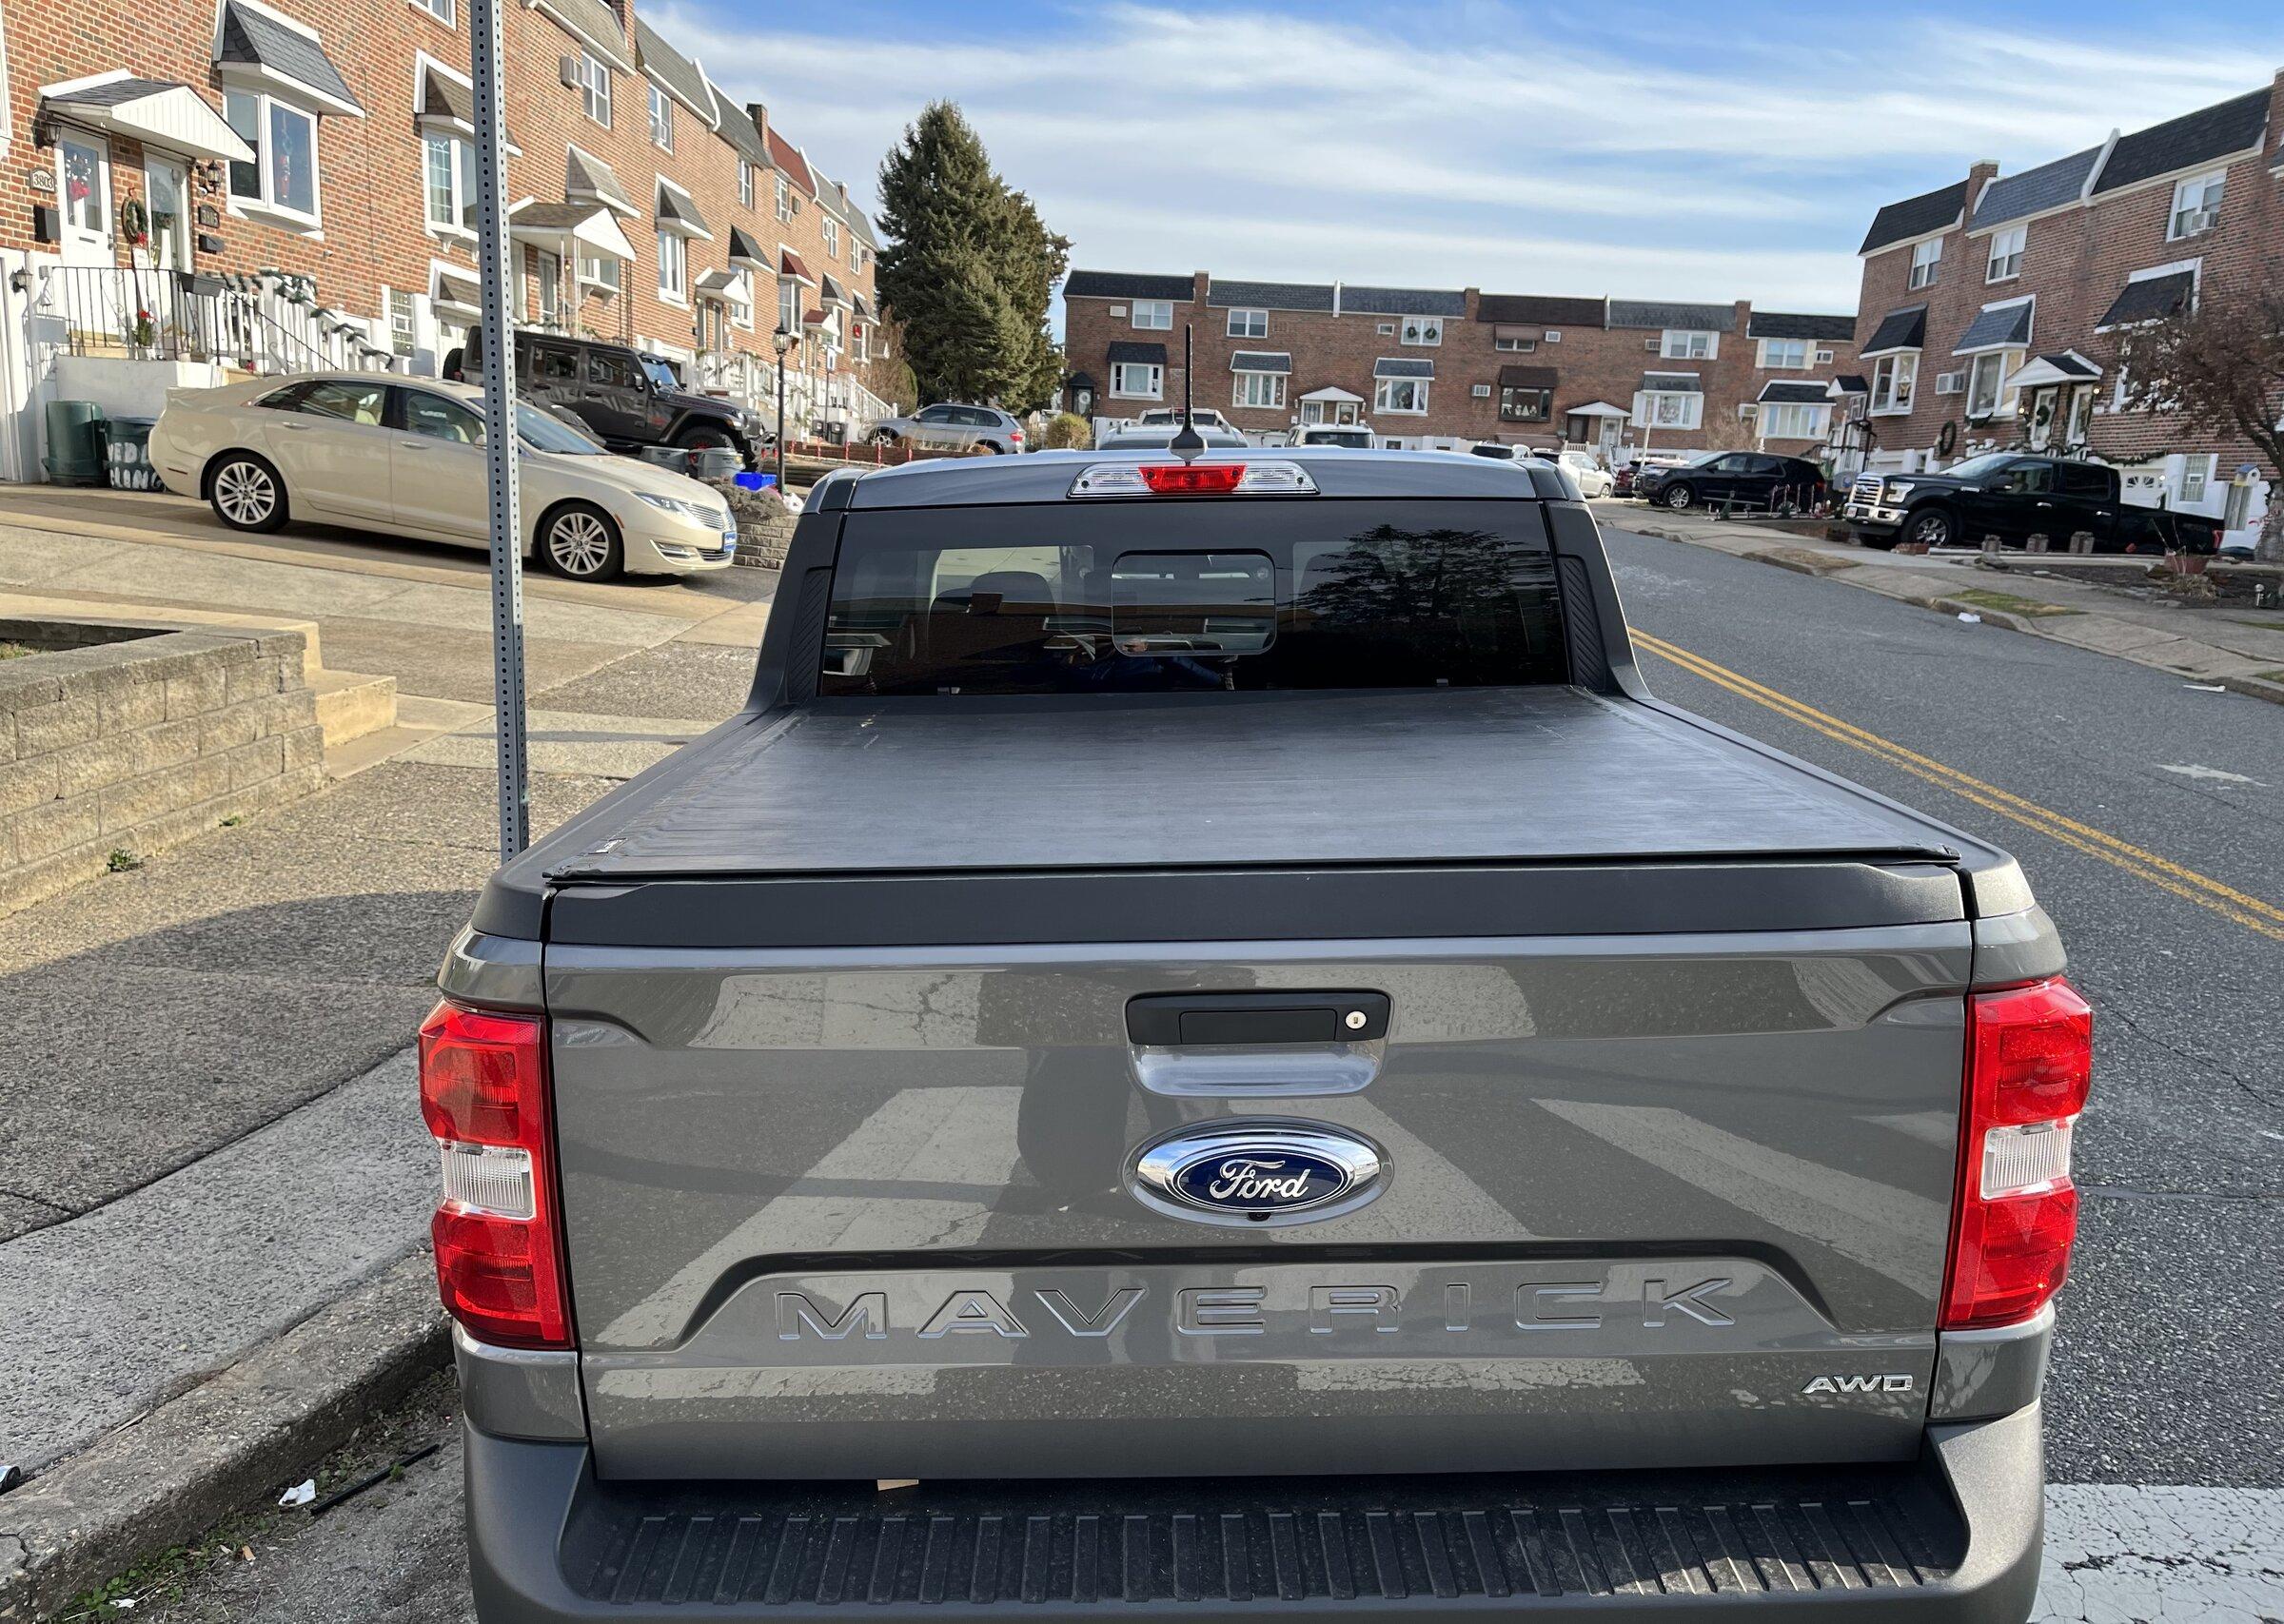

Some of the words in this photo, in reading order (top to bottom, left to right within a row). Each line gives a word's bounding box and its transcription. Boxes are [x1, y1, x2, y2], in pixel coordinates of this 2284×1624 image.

[33, 173, 54, 189] 3803
[1209, 1159, 1310, 1199] Ford
[774, 1278, 1736, 1340] MAVERICK
[1801, 1374, 1914, 1394] AWD
